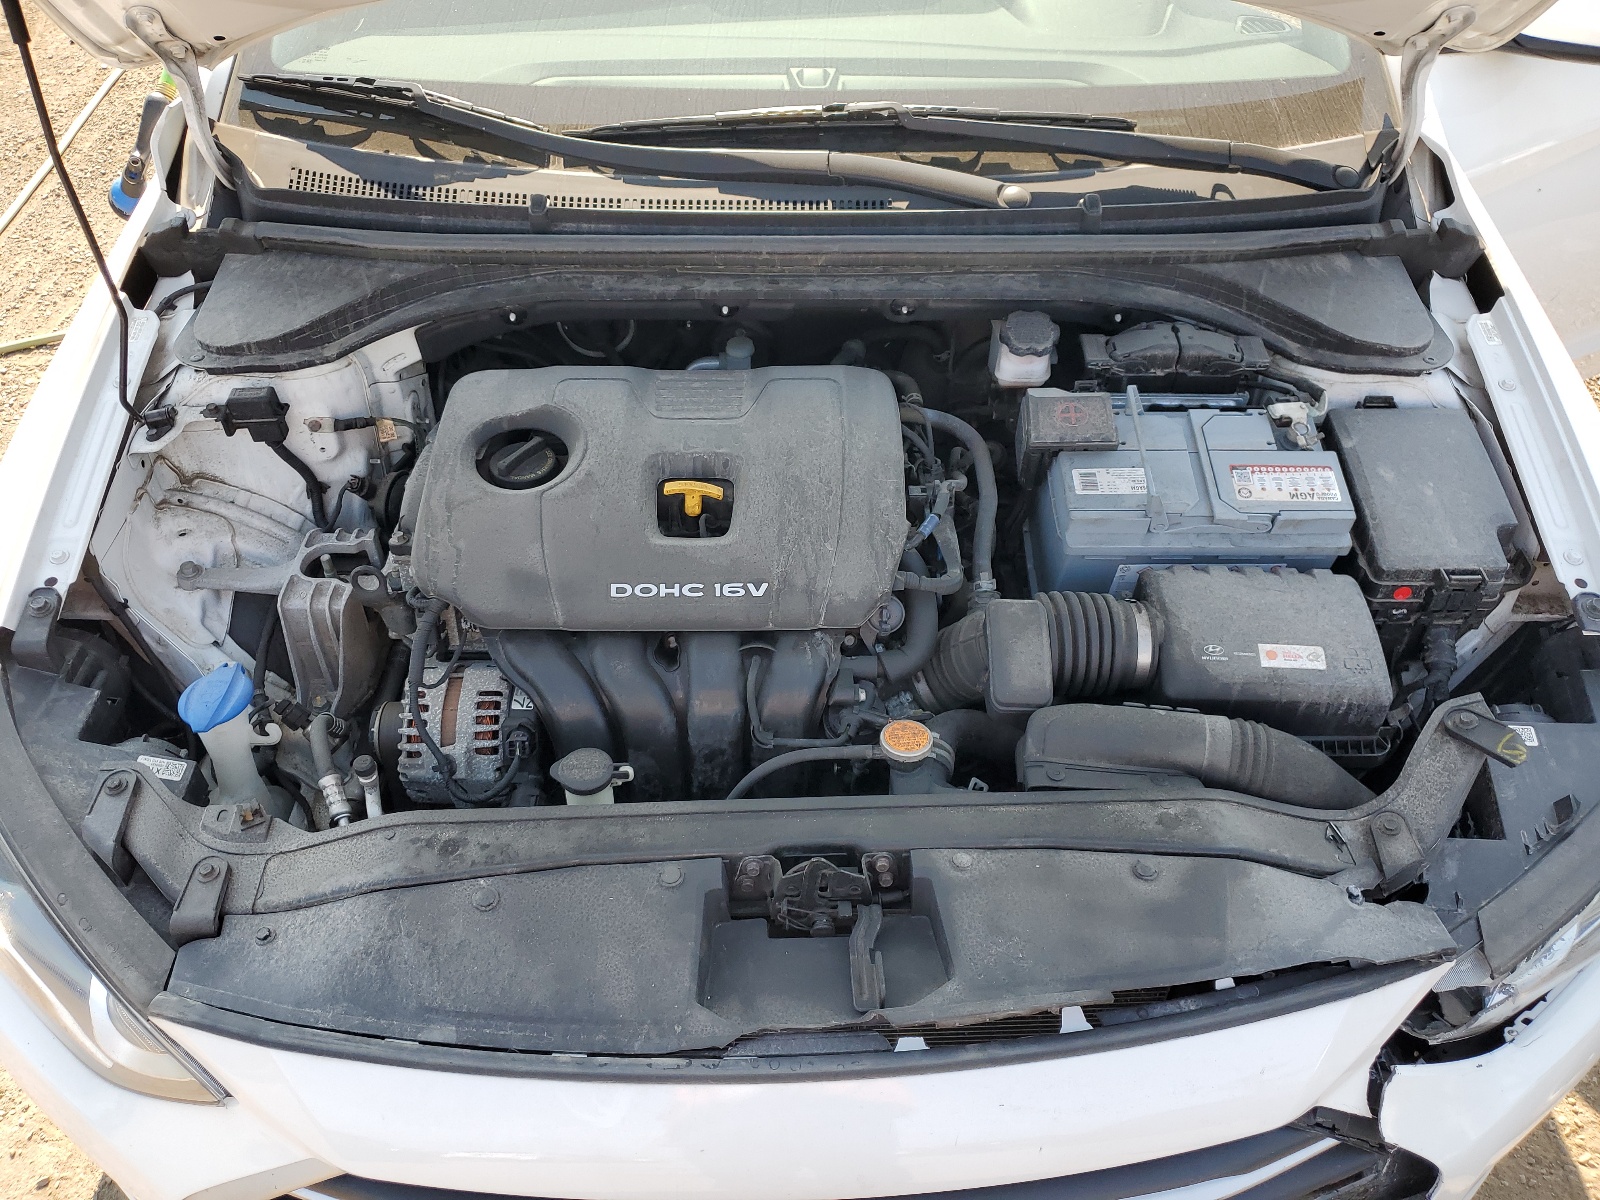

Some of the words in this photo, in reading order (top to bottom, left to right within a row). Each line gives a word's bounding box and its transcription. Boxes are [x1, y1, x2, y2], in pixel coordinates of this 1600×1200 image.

[1289, 492, 1315, 500] AGM
[610, 583, 705, 598] DOHC
[714, 583, 769, 598] 16V
